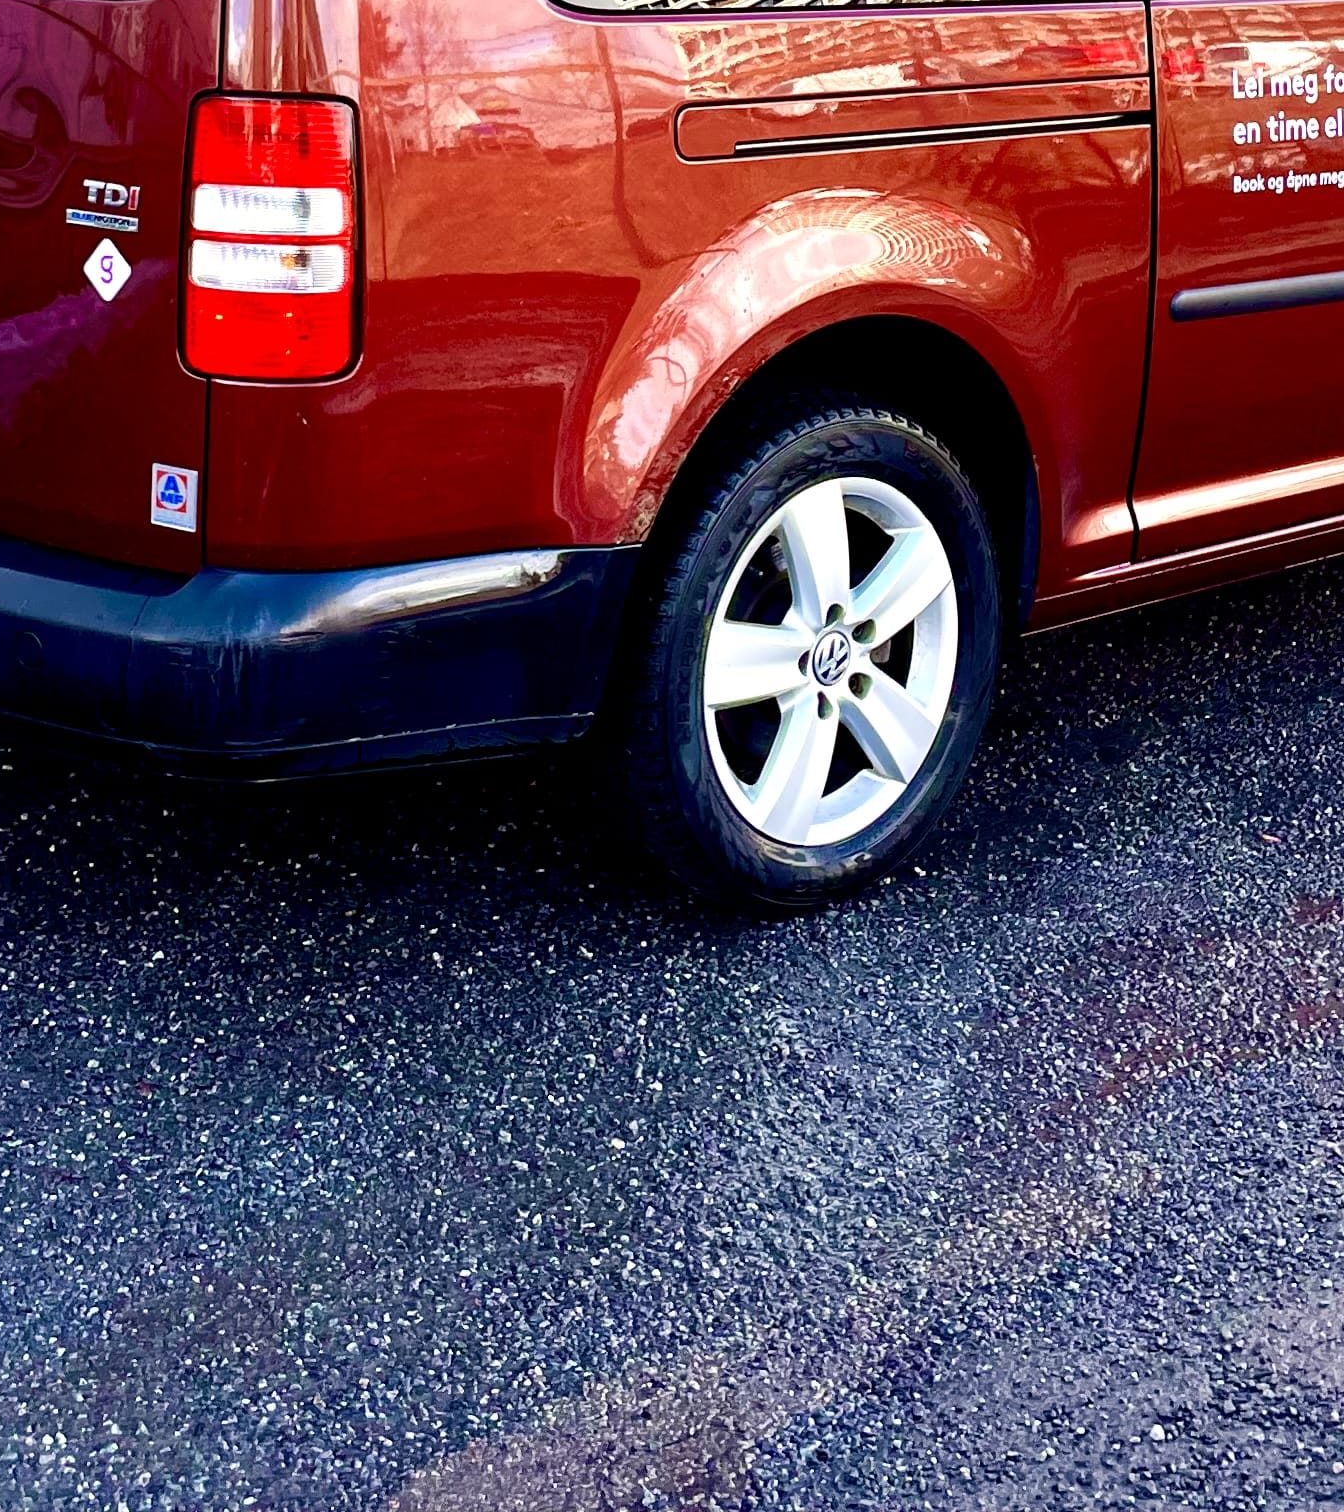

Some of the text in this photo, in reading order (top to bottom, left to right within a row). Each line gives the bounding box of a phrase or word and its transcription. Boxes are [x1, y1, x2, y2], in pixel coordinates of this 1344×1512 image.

[1270, 71, 1318, 104] meg
[1233, 120, 1261, 145] en
[1266, 110, 1320, 142] time
[83, 178, 141, 210] TDI
[1233, 173, 1266, 193] Book
[1267, 179, 1284, 194] og
[1286, 169, 1317, 192] åpne
[163, 475, 180, 493] A
